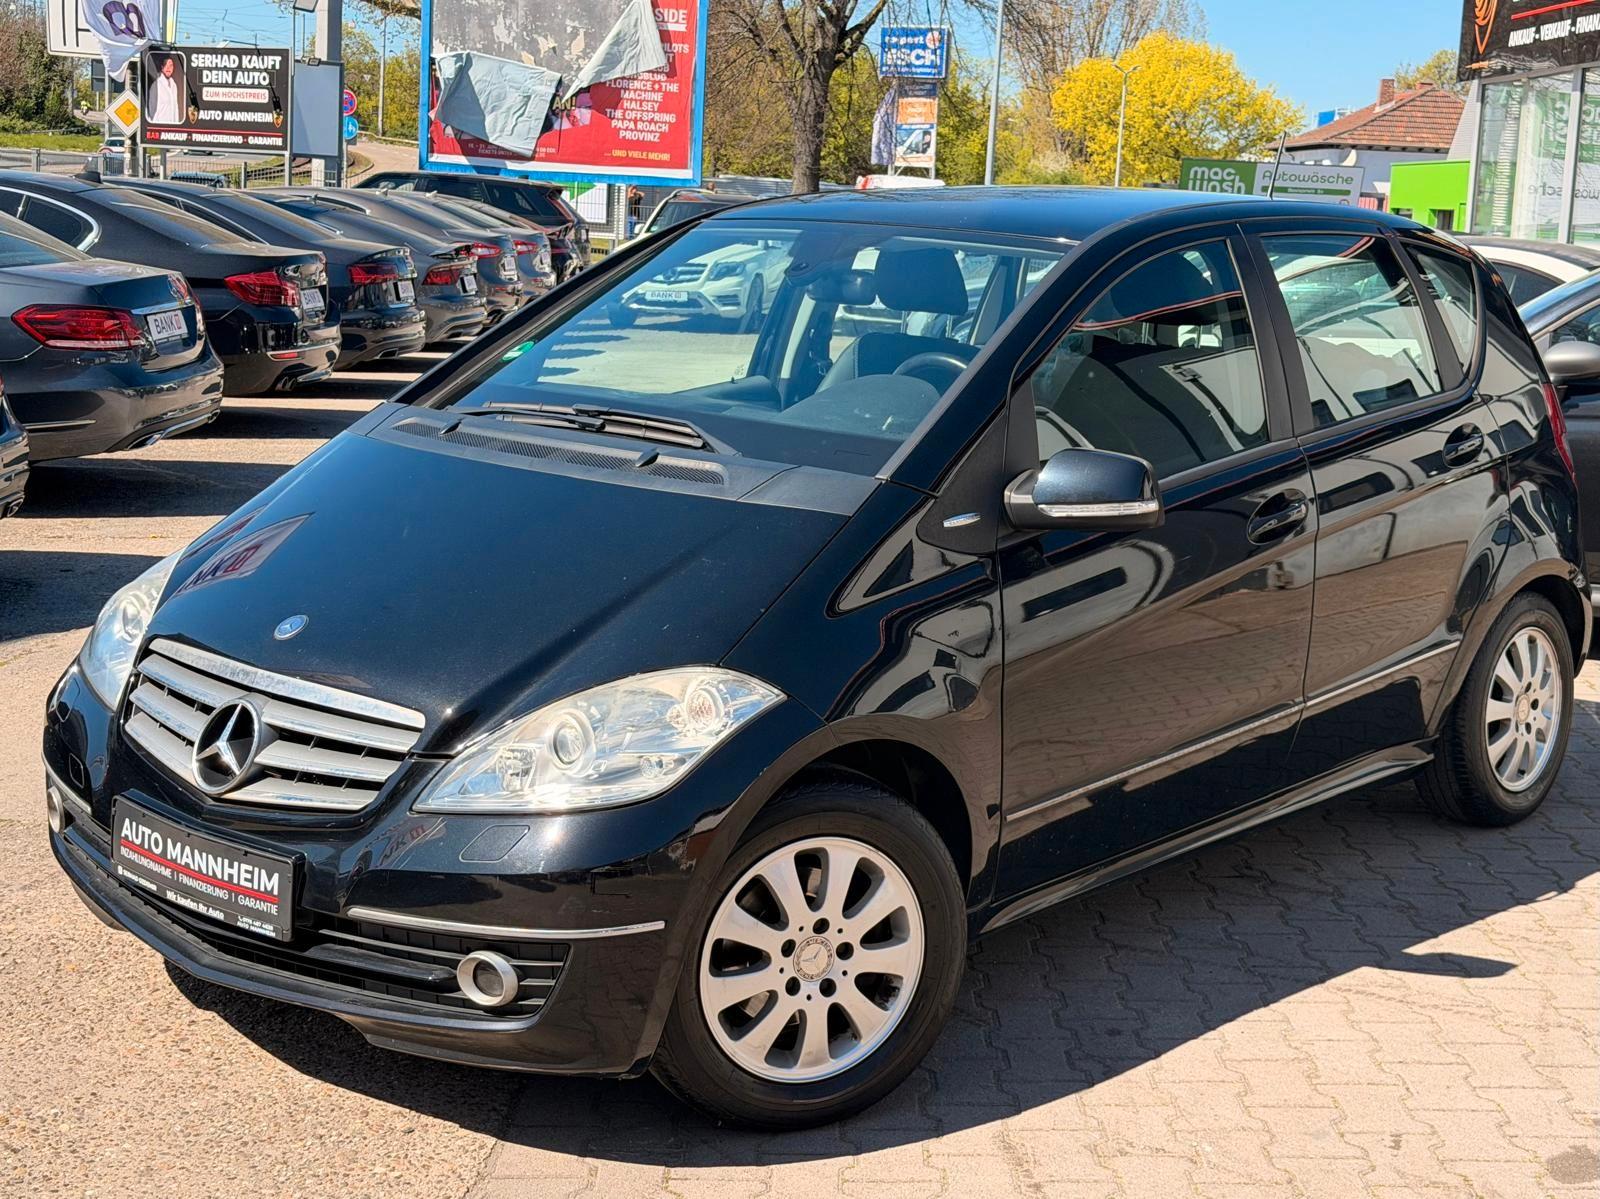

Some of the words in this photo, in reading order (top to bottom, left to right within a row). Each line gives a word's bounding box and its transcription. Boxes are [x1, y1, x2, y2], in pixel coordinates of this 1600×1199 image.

[655, 8, 688, 23] SIDE
[1508, 26, 1537, 47] ANKAUF
[1540, 19, 1572, 41] VERKAUF
[664, 43, 689, 53] ILOTS
[191, 53, 239, 69] SERHAD
[242, 54, 281, 70] KAUFT
[202, 70, 233, 84] DEIN
[236, 71, 269, 85] AUTO
[606, 79, 654, 90] FLORENCE
[660, 83, 679, 92] THE
[205, 90, 220, 98] ZUM
[621, 89, 664, 101] MACHINE
[623, 101, 660, 111] HALSEY
[198, 110, 223, 121] AUTO
[223, 111, 273, 123] MANNHEIM
[605, 108, 624, 118] THE
[625, 110, 676, 123] OFFSPRING
[611, 120, 635, 129] PAPA
[637, 122, 669, 132] ROACH
[160, 132, 188, 141] ANKAUF
[192, 134, 244, 144] FINANZIERUNG
[247, 137, 283, 146] GARANTIE
[619, 130, 660, 142] PROVINZ
[628, 150, 648, 159] VIELE
[1189, 166, 1235, 180] mac
[1188, 176, 1246, 195] wash
[120, 818, 163, 854] AUTO
[166, 838, 280, 896] MANNHEIM
[179, 873, 229, 901] FINANZIERUNG
[238, 894, 279, 916] GARANTIE
[177, 893, 197, 912] kaufen
[208, 907, 225, 922] Auto
